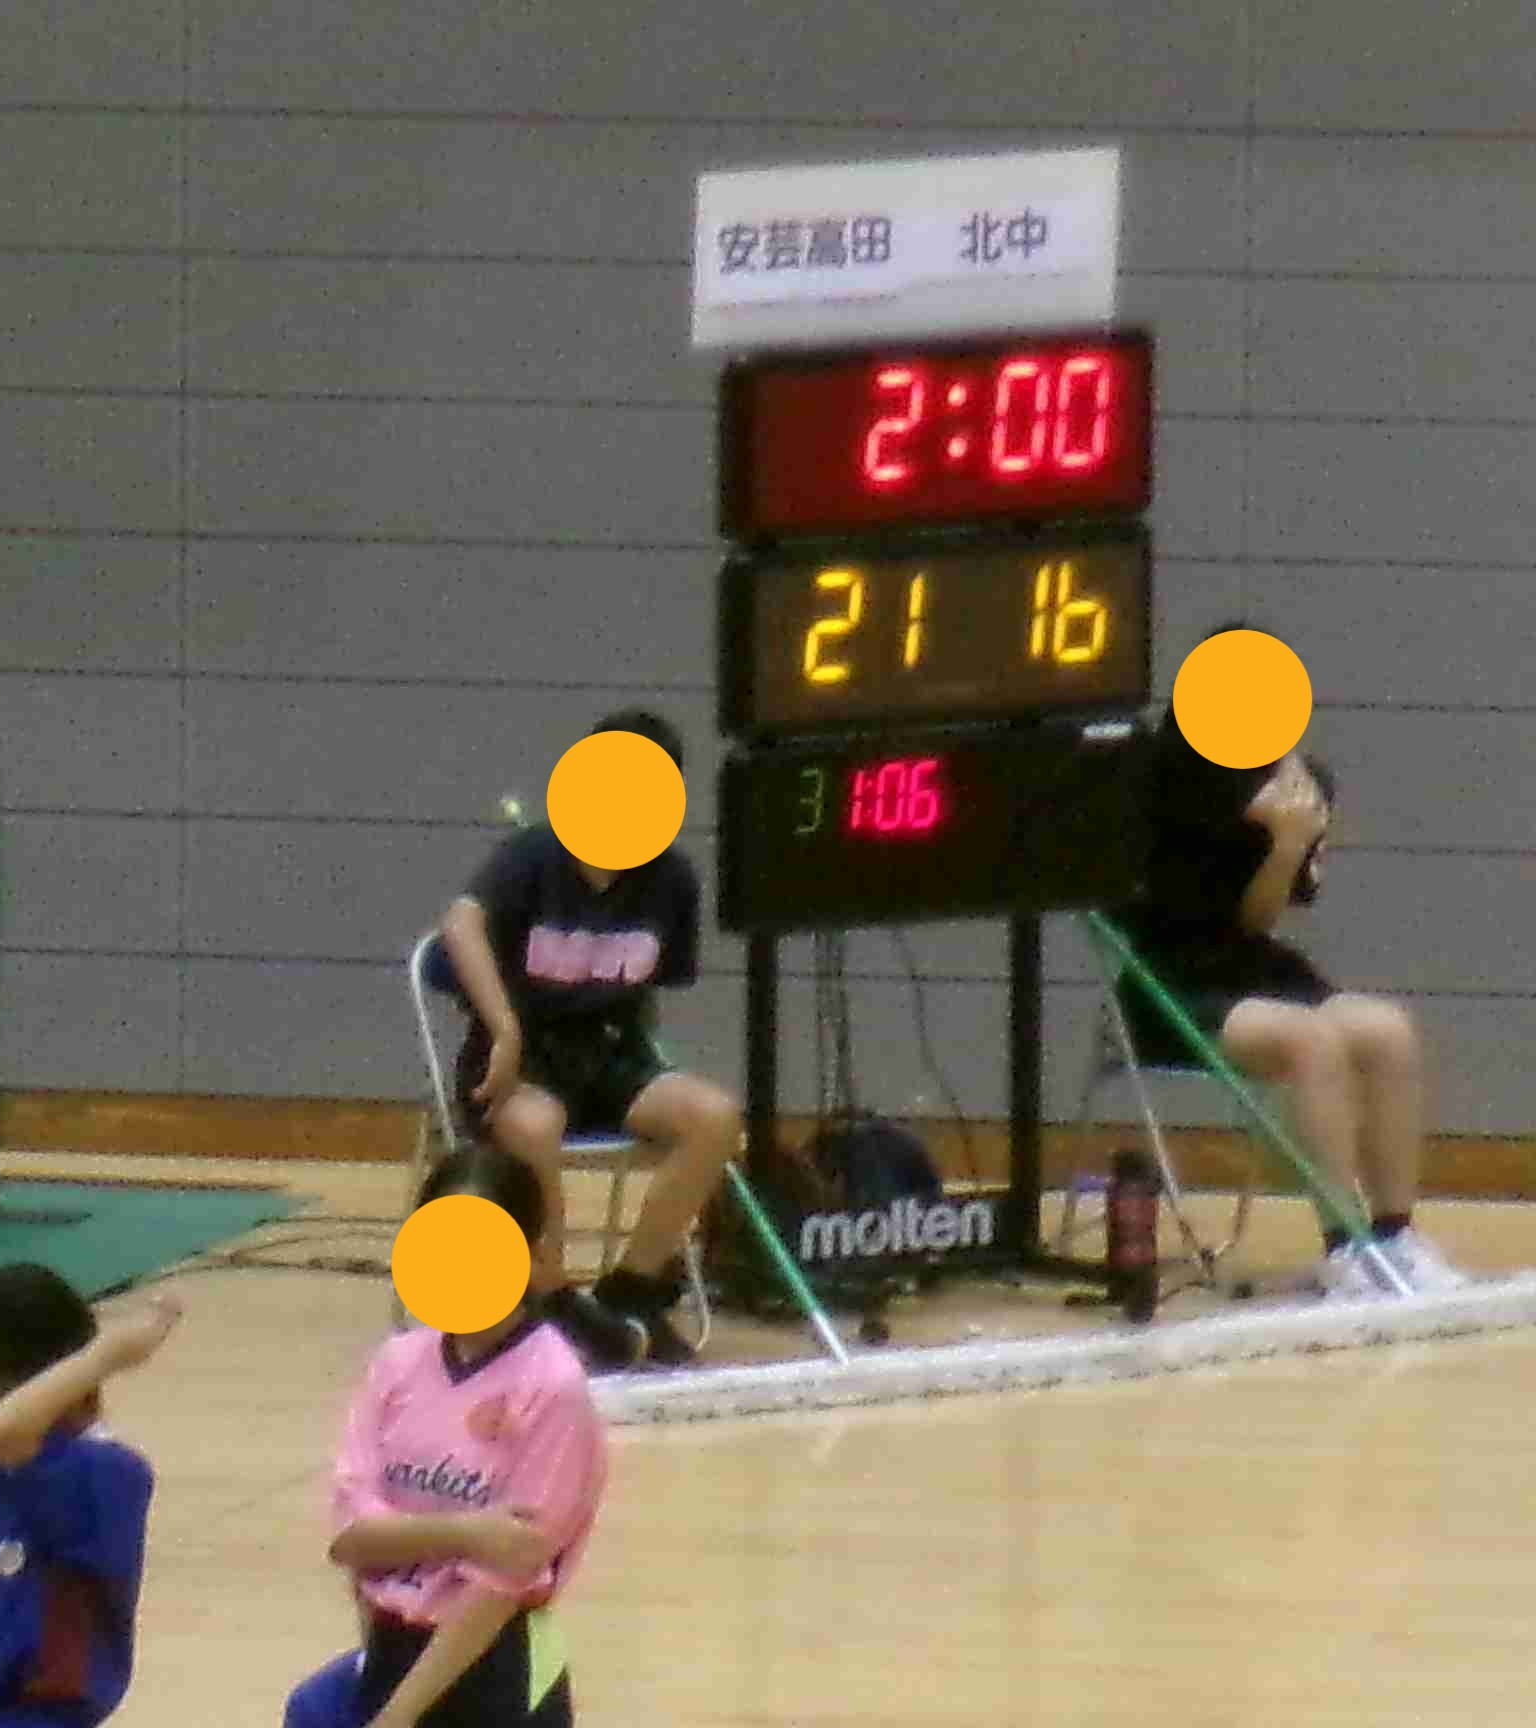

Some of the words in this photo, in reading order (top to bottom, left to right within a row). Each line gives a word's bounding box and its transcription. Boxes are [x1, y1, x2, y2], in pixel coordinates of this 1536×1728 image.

[717, 216, 892, 274] 安芸高田
[960, 206, 1048, 266] 北中
[864, 356, 1112, 482] 2:00
[804, 571, 926, 684] 21
[1029, 561, 1109, 664] 16
[800, 1198, 996, 1261] molten
